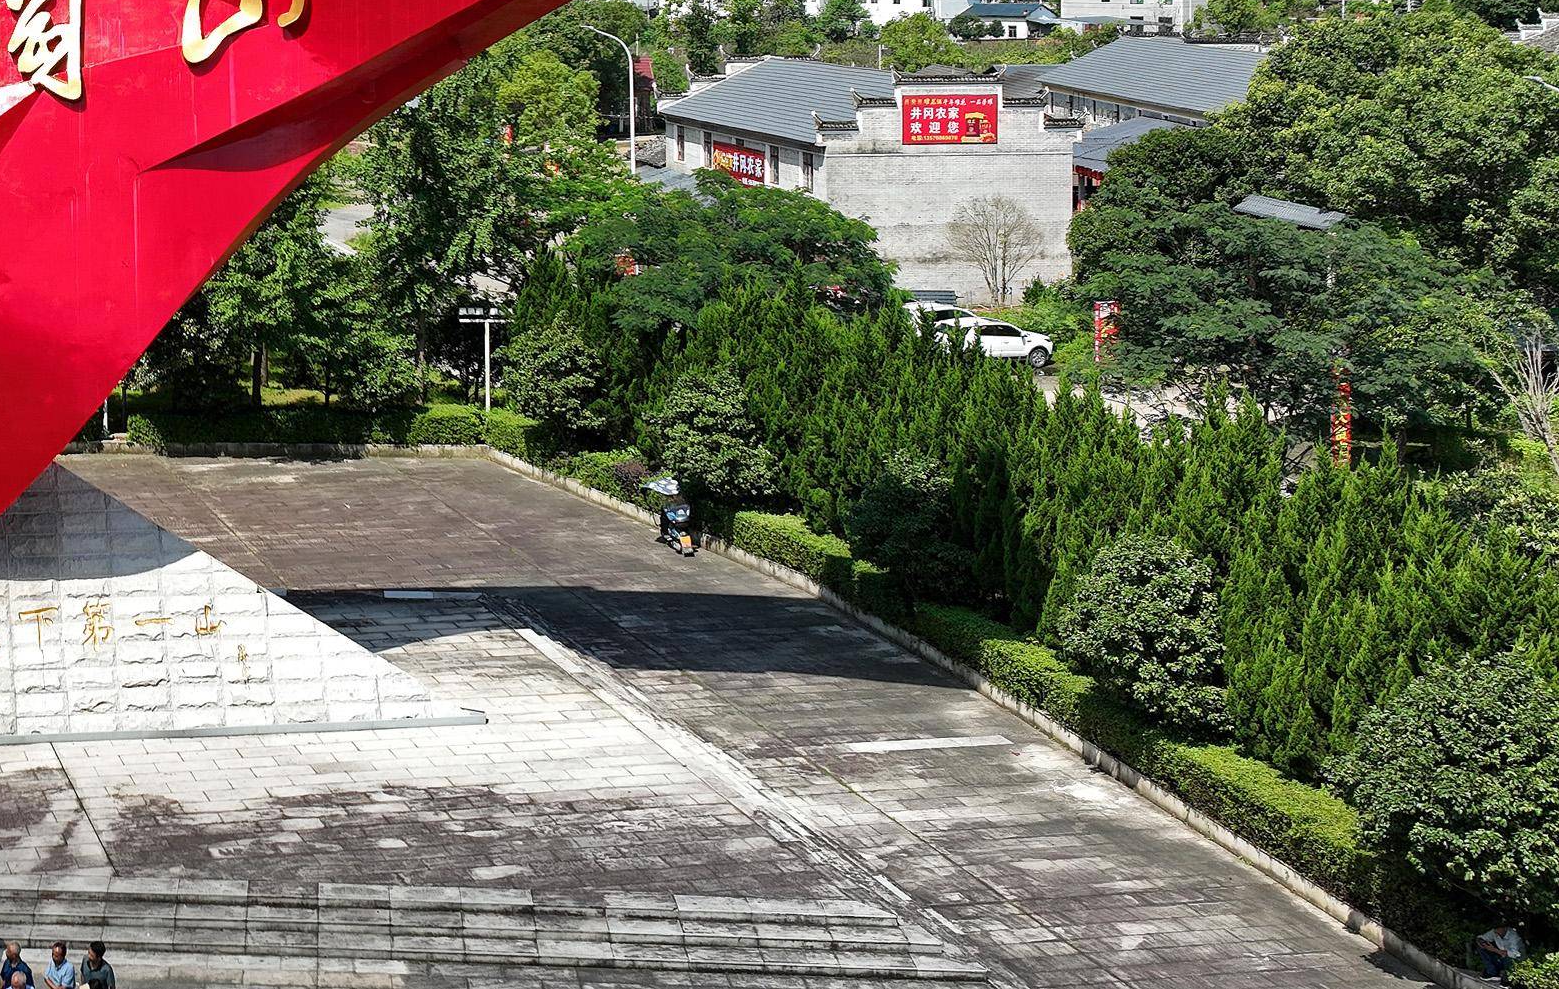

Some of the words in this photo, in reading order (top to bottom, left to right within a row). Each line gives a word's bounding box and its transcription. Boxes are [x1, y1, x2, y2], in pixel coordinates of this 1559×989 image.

[910, 107, 959, 120] 井冈农家
[910, 122, 959, 134] 欢迎您
